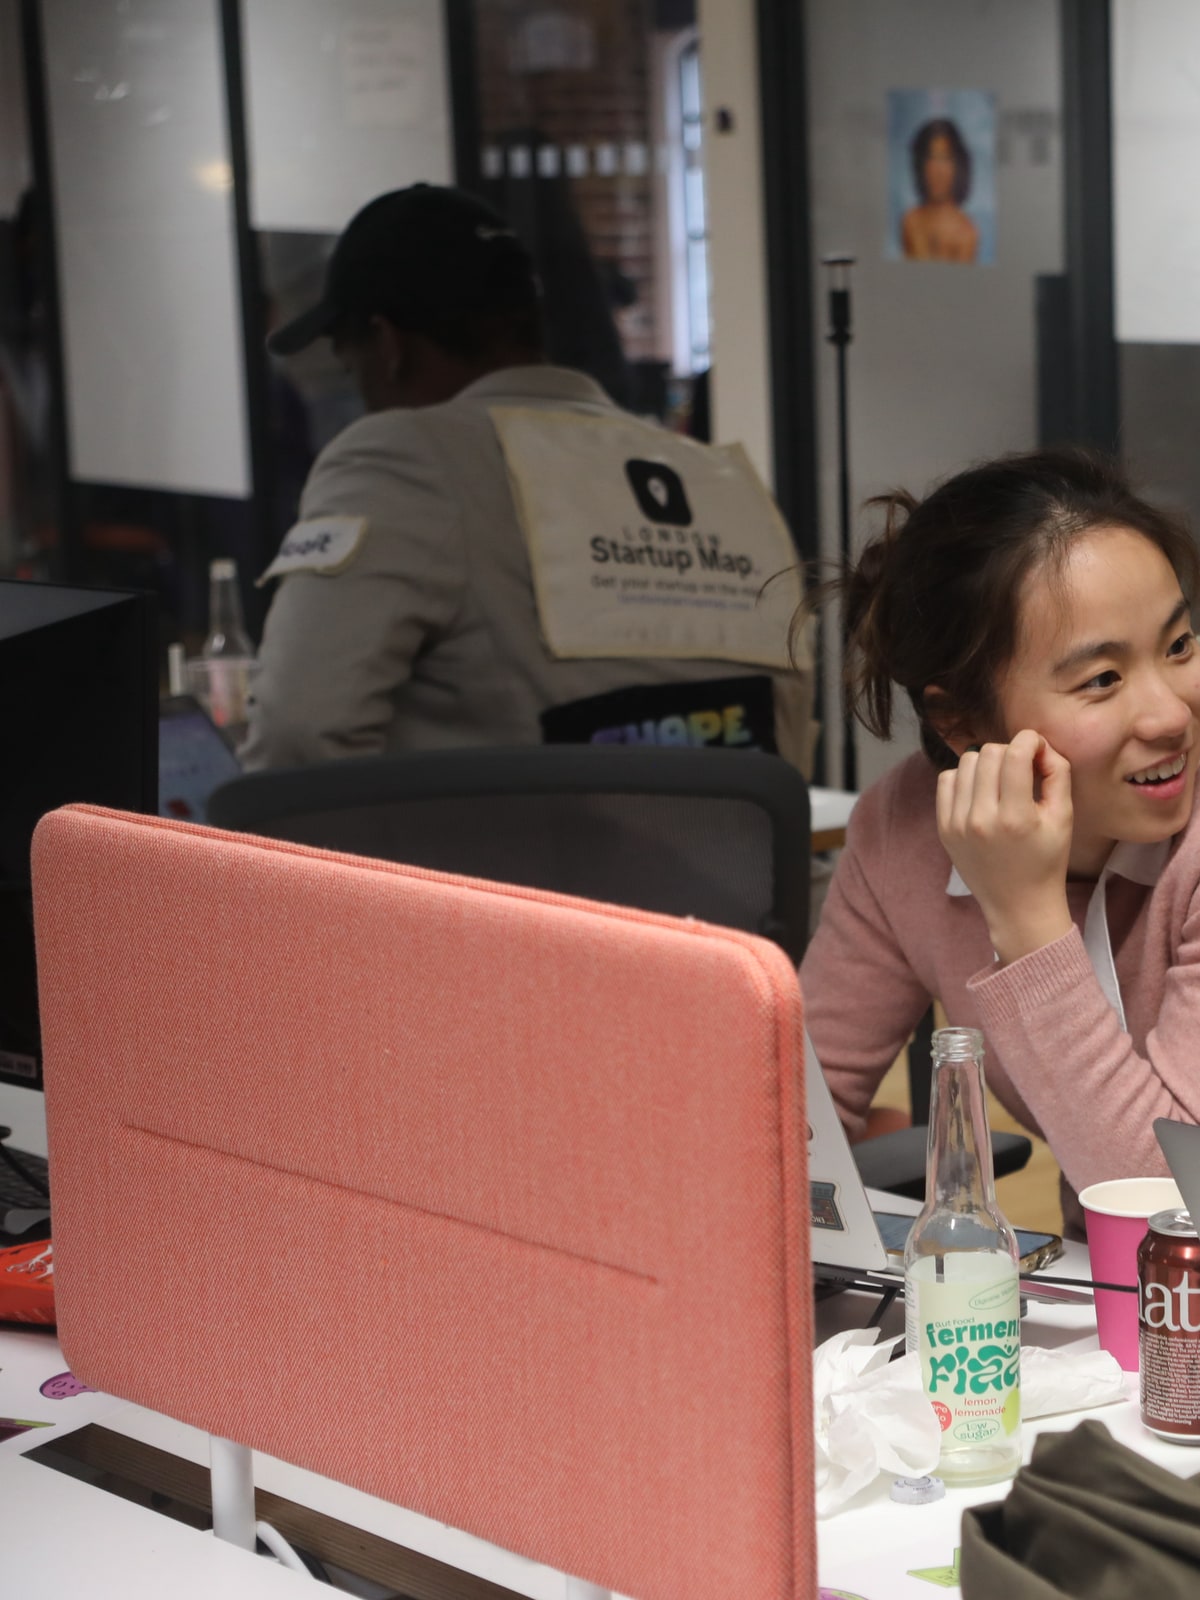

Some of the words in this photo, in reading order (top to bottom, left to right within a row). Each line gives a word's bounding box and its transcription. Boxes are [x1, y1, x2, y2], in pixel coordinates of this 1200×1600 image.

[590, 535, 693, 575] Startup
[964, 1397, 997, 1406] lemon
[955, 1406, 1006, 1417] lemonade
[966, 1422, 987, 1431] low
[960, 1427, 996, 1440] sugar
